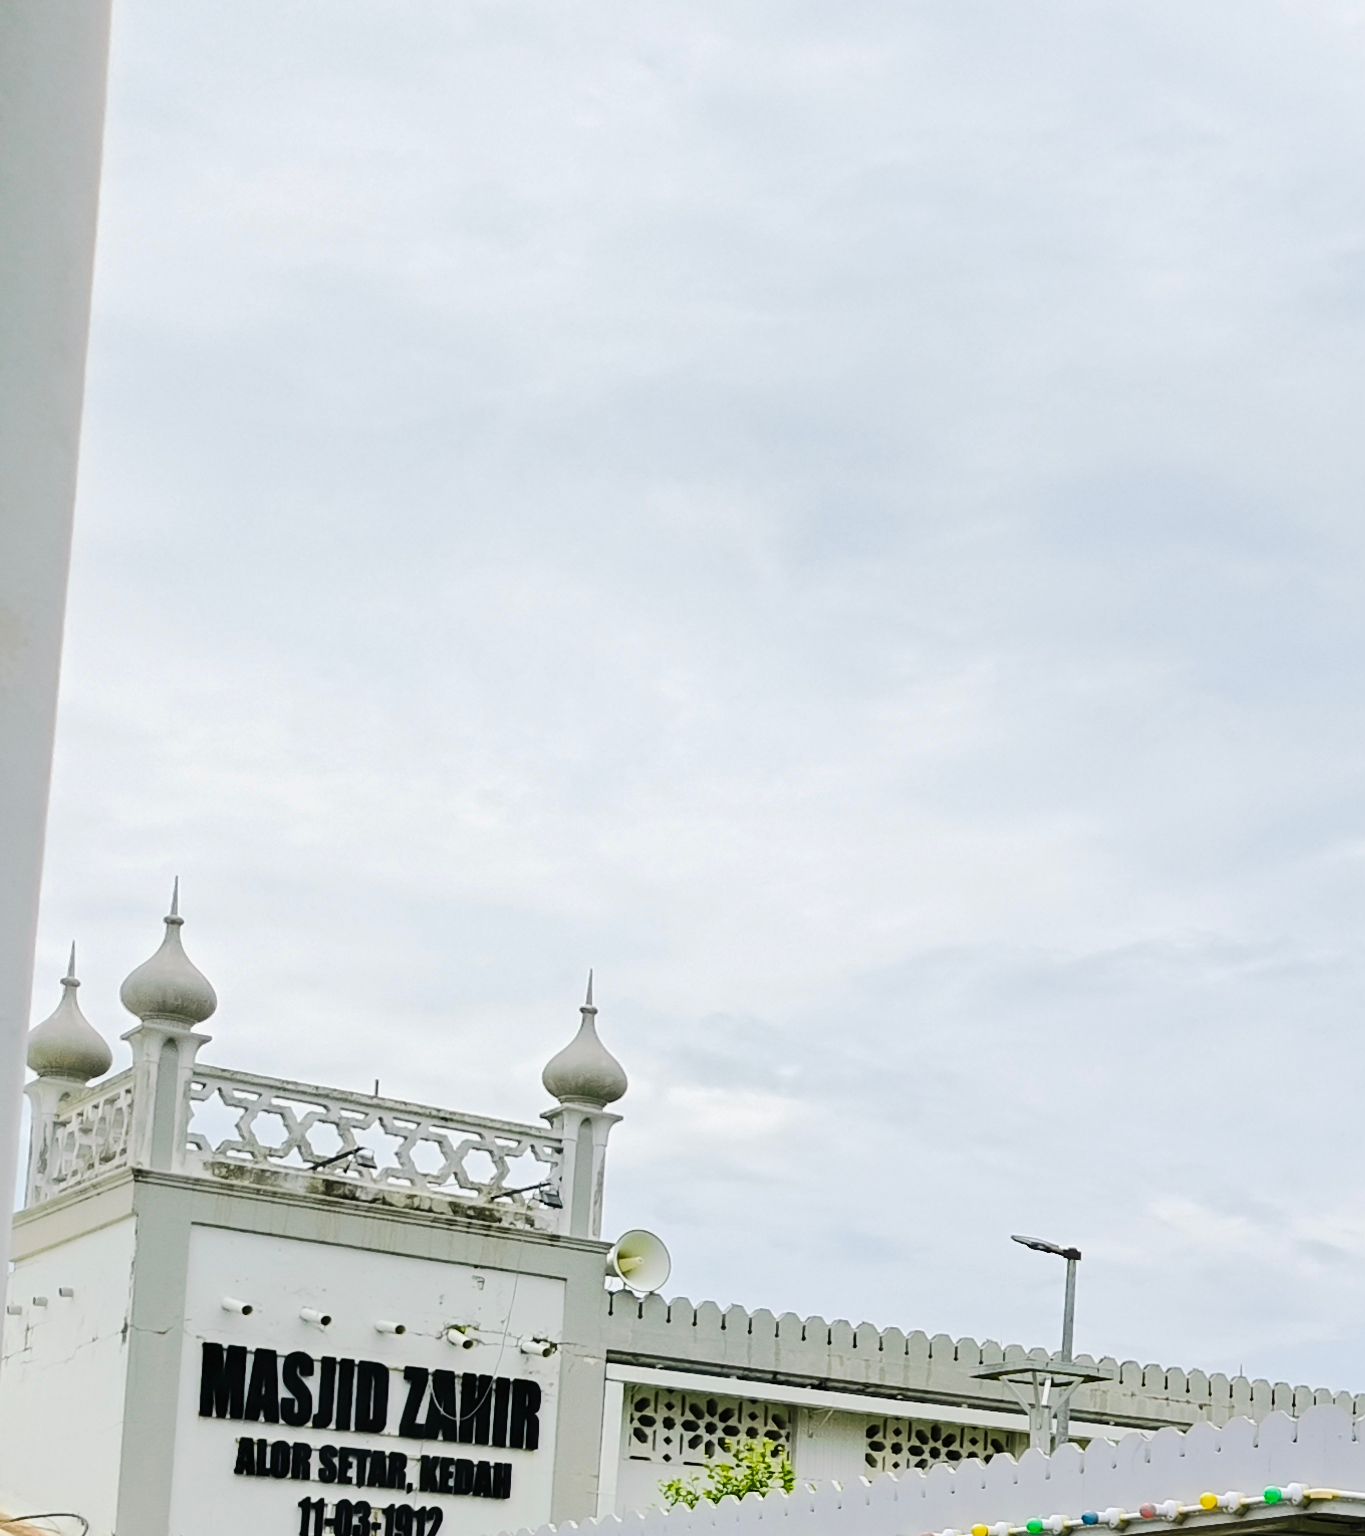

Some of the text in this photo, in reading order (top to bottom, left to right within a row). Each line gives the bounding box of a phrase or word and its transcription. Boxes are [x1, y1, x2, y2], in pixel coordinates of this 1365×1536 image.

[199, 1342, 542, 1450] MASJID ZAHIR
[234, 1437, 512, 1499] ALOR SETAR, KEDAH
